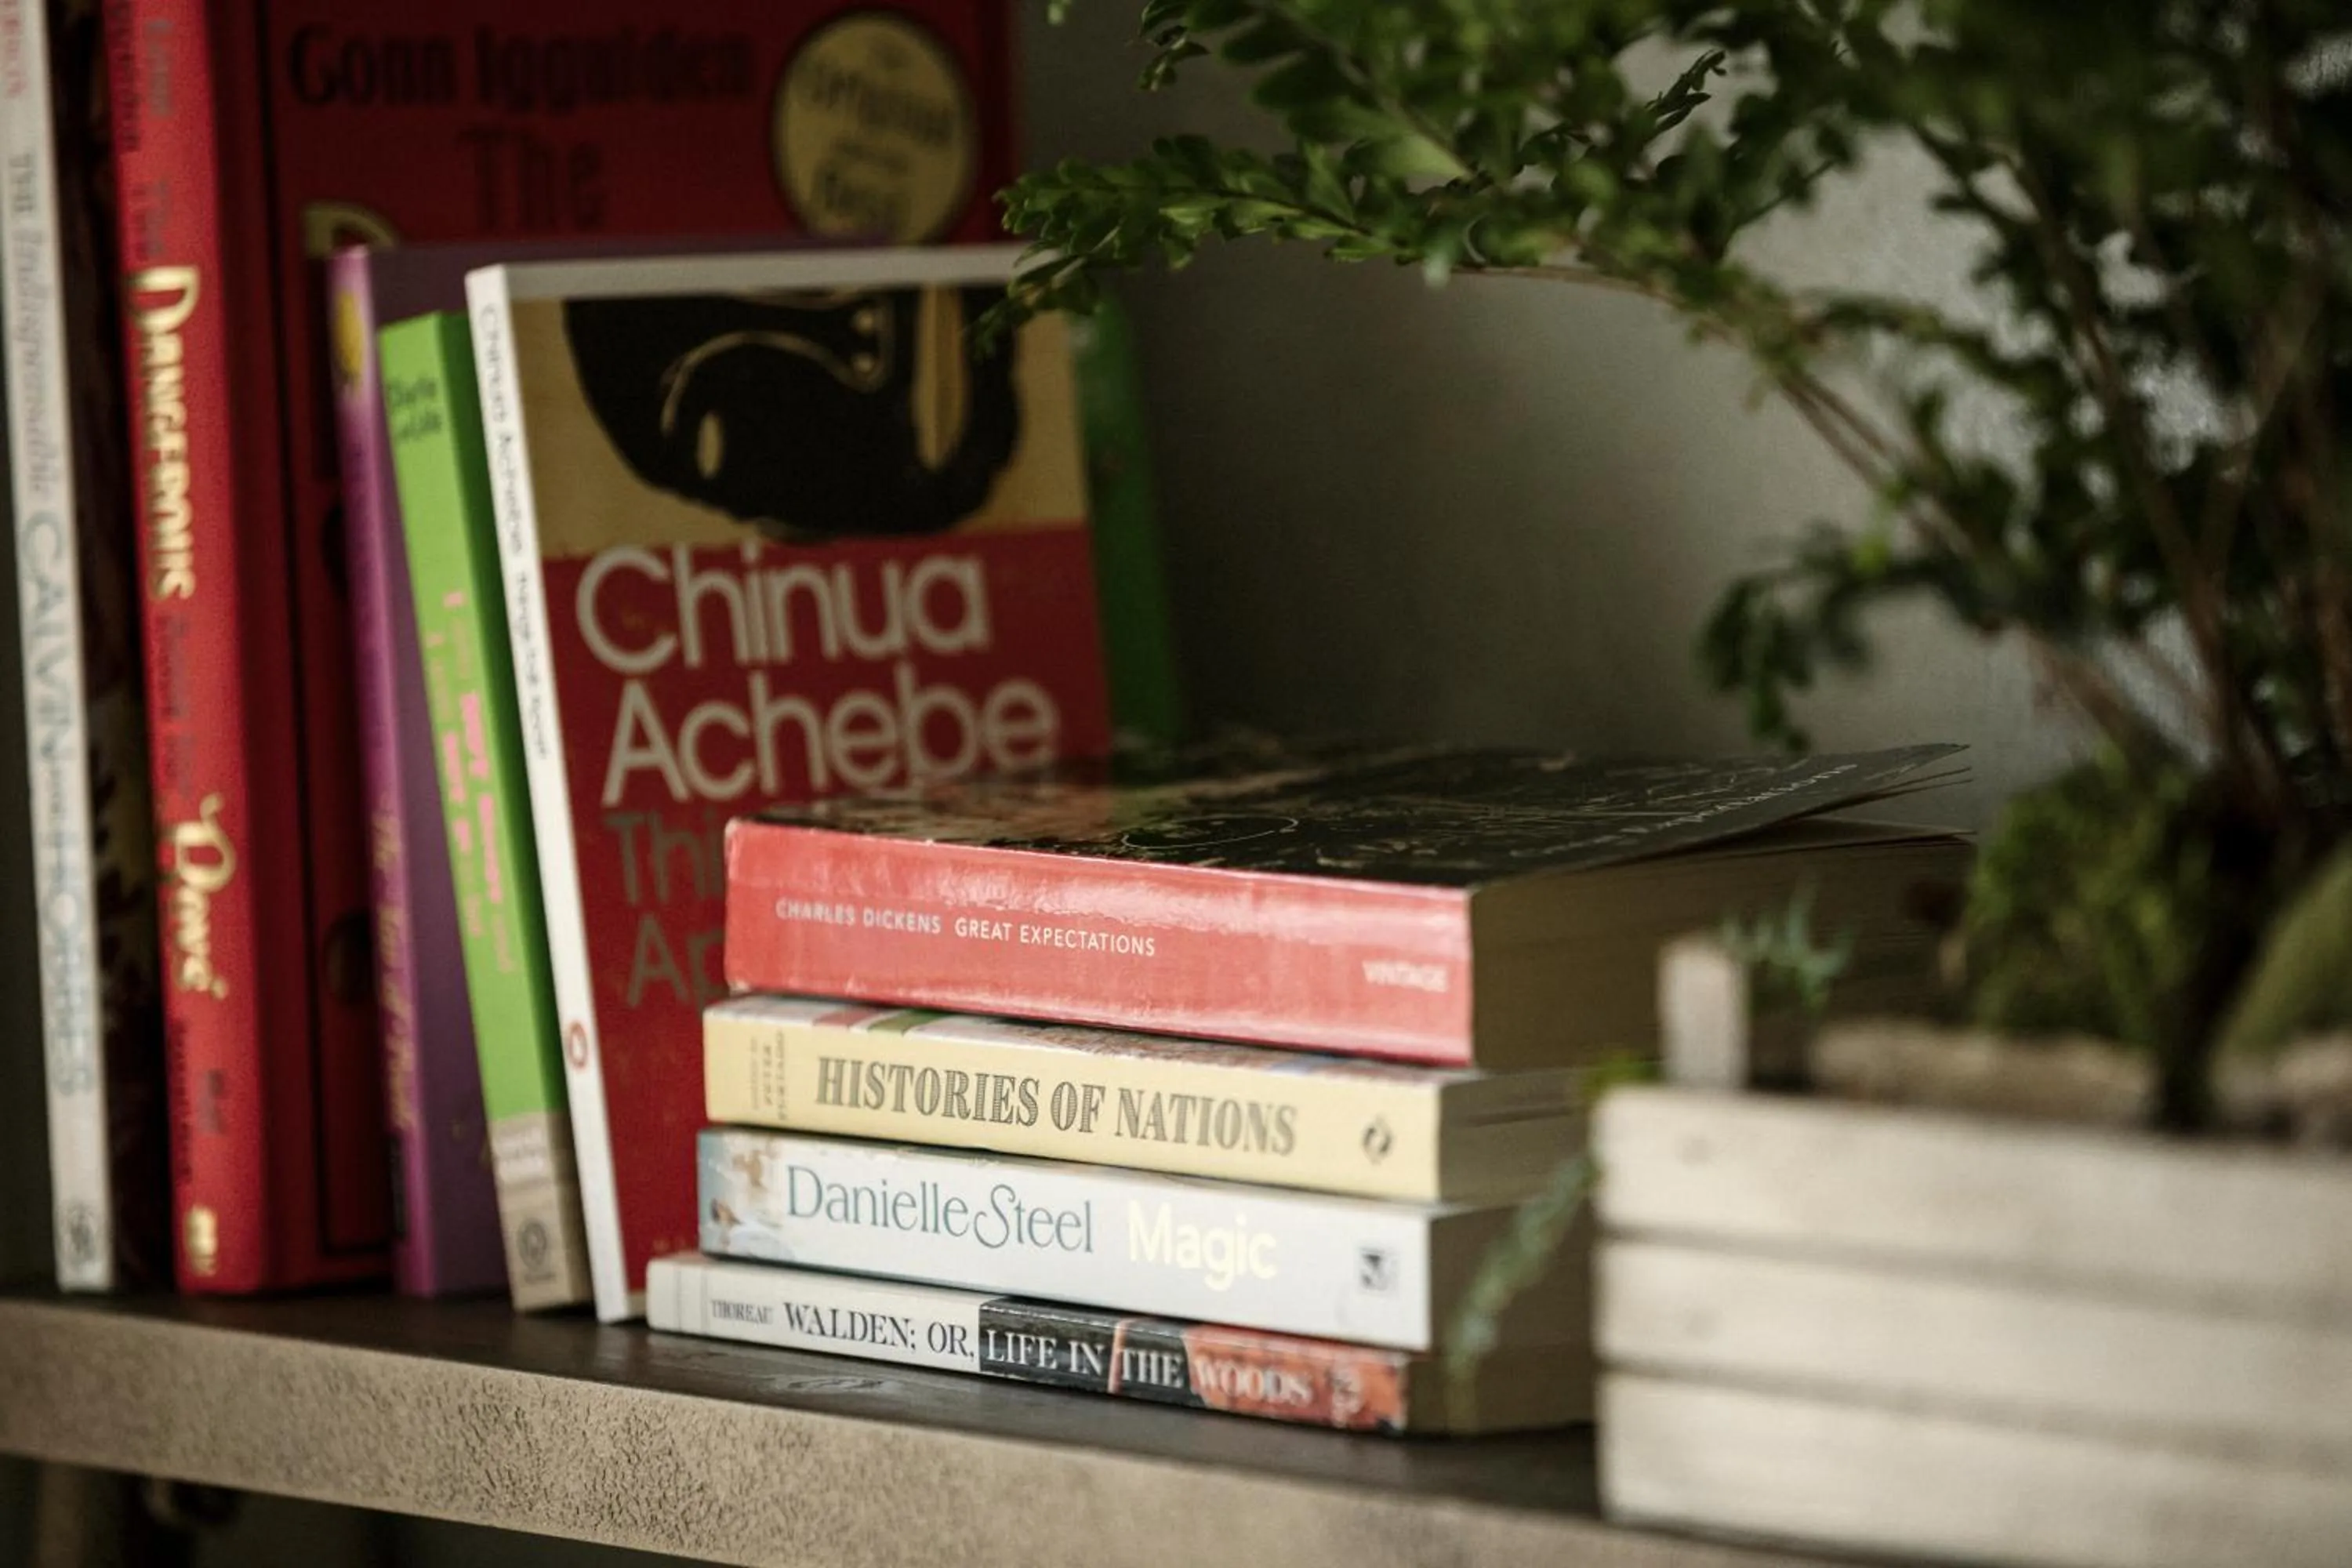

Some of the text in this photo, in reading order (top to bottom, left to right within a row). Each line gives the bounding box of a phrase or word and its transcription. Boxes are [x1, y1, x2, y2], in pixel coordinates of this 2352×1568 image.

[575, 539, 993, 674] Chinua
[601, 659, 1059, 806] Achebe
[775, 898, 1156, 957] CHARLES DICKENS GREAT EXPECTATIONS
[816, 1055, 1040, 1127] HISTORIES
[1050, 1080, 1106, 1134] OF
[1114, 1087, 1298, 1157] NATIONS
[787, 1166, 1094, 1253] Danielle Steel
[1127, 1200, 1278, 1290] Magic
[711, 1300, 774, 1325] THOREAU
[783, 1301, 1316, 1406] WALDEN; OR, LIFE IN THE WOODS
